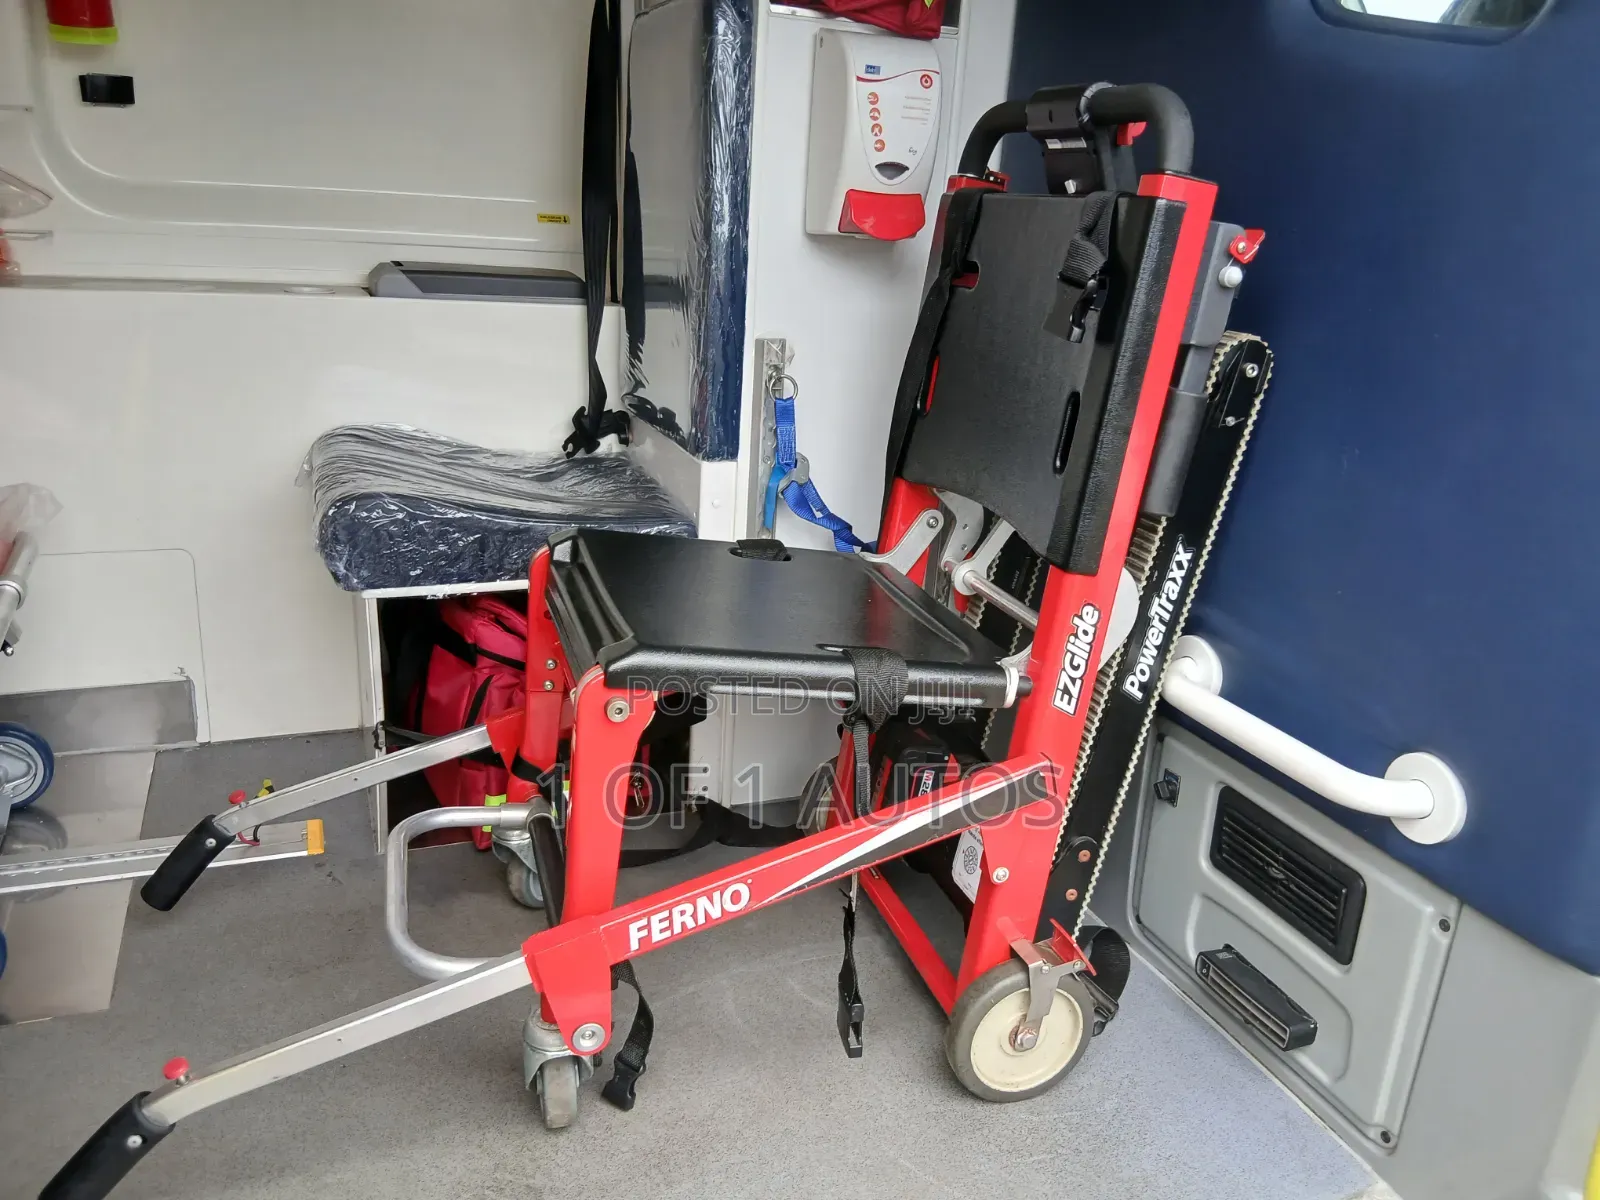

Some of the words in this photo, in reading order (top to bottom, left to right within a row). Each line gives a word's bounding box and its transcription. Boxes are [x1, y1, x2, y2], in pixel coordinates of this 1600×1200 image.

[1053, 603, 1100, 715] EZGlide
[1123, 542, 1194, 700] PowerTraxx
[628, 881, 751, 952] FERNO
